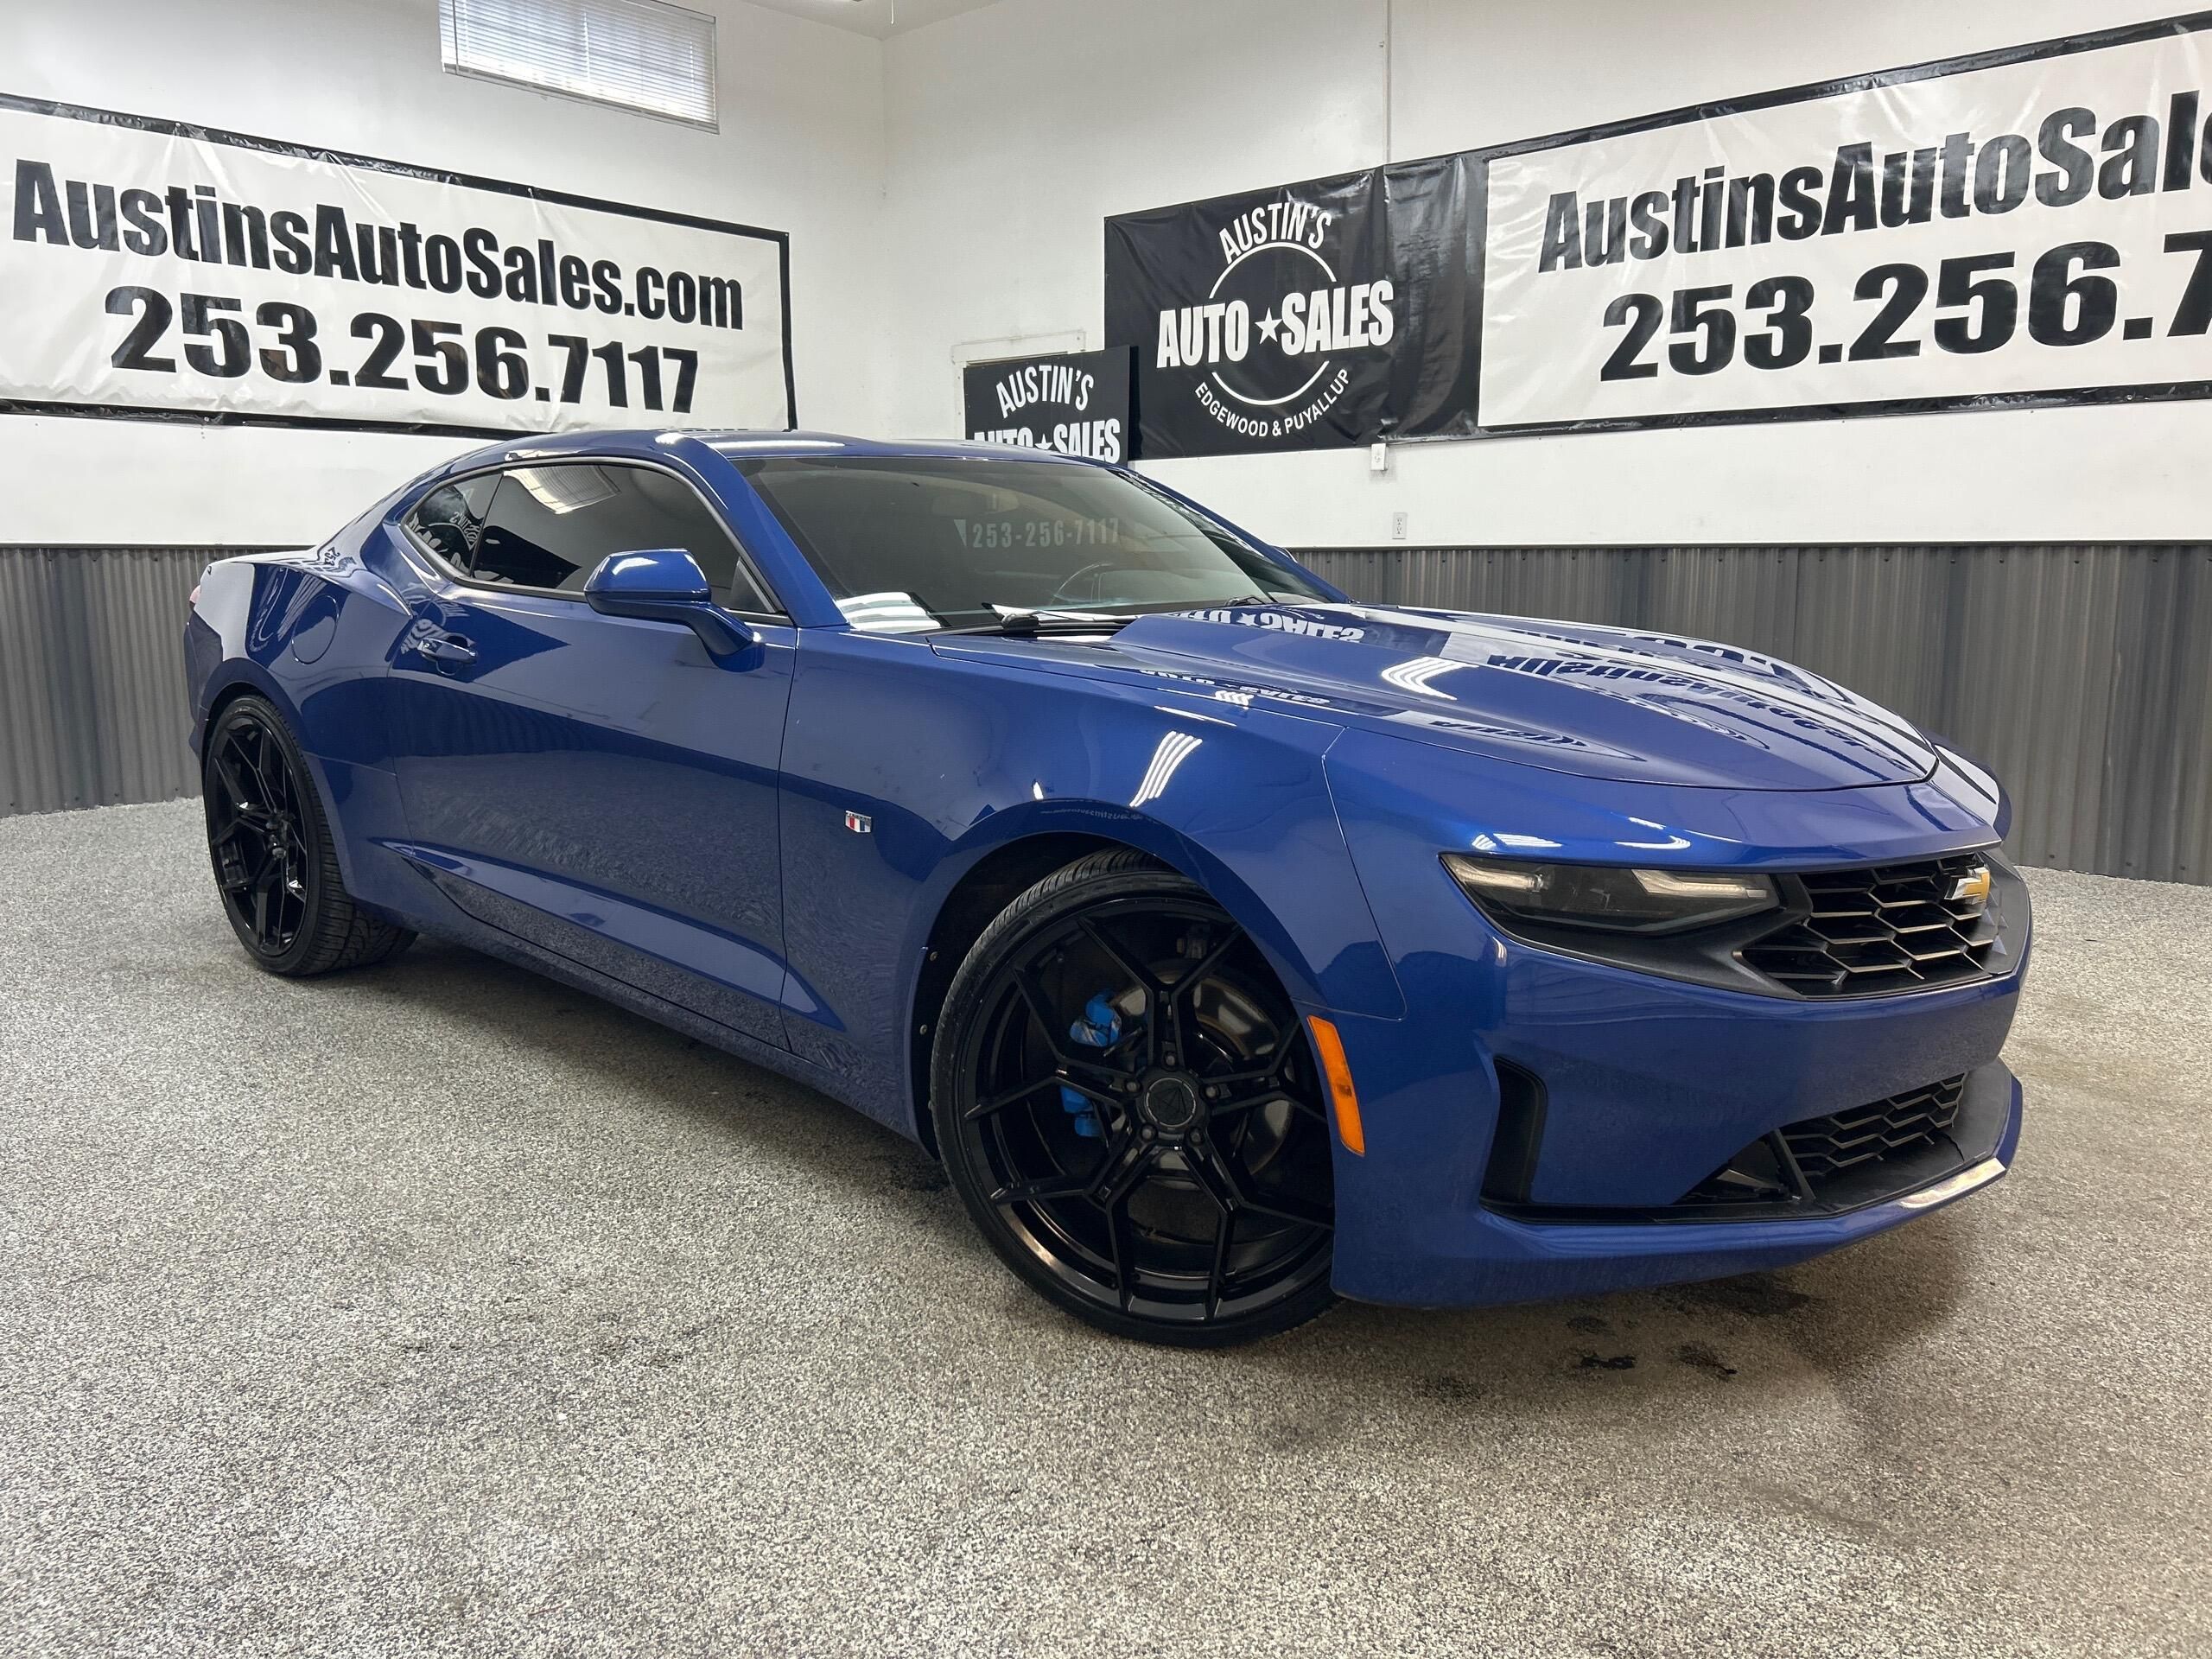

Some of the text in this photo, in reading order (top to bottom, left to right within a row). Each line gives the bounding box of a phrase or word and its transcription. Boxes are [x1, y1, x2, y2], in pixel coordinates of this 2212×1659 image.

[1538, 91, 2212, 272] AustinsAutoSal
[13, 160, 743, 330] AustinsAutoSales.com
[1218, 201, 1333, 265] AUSTIN'S
[105, 286, 698, 414] 253.256.7117
[1156, 279, 1394, 369] AUTO SALES
[995, 365, 1095, 419] AUSTIN'S
[1194, 368, 1350, 437] EDGEWOOD & PUYALLUP
[972, 518, 1119, 549] 253-256-7117
